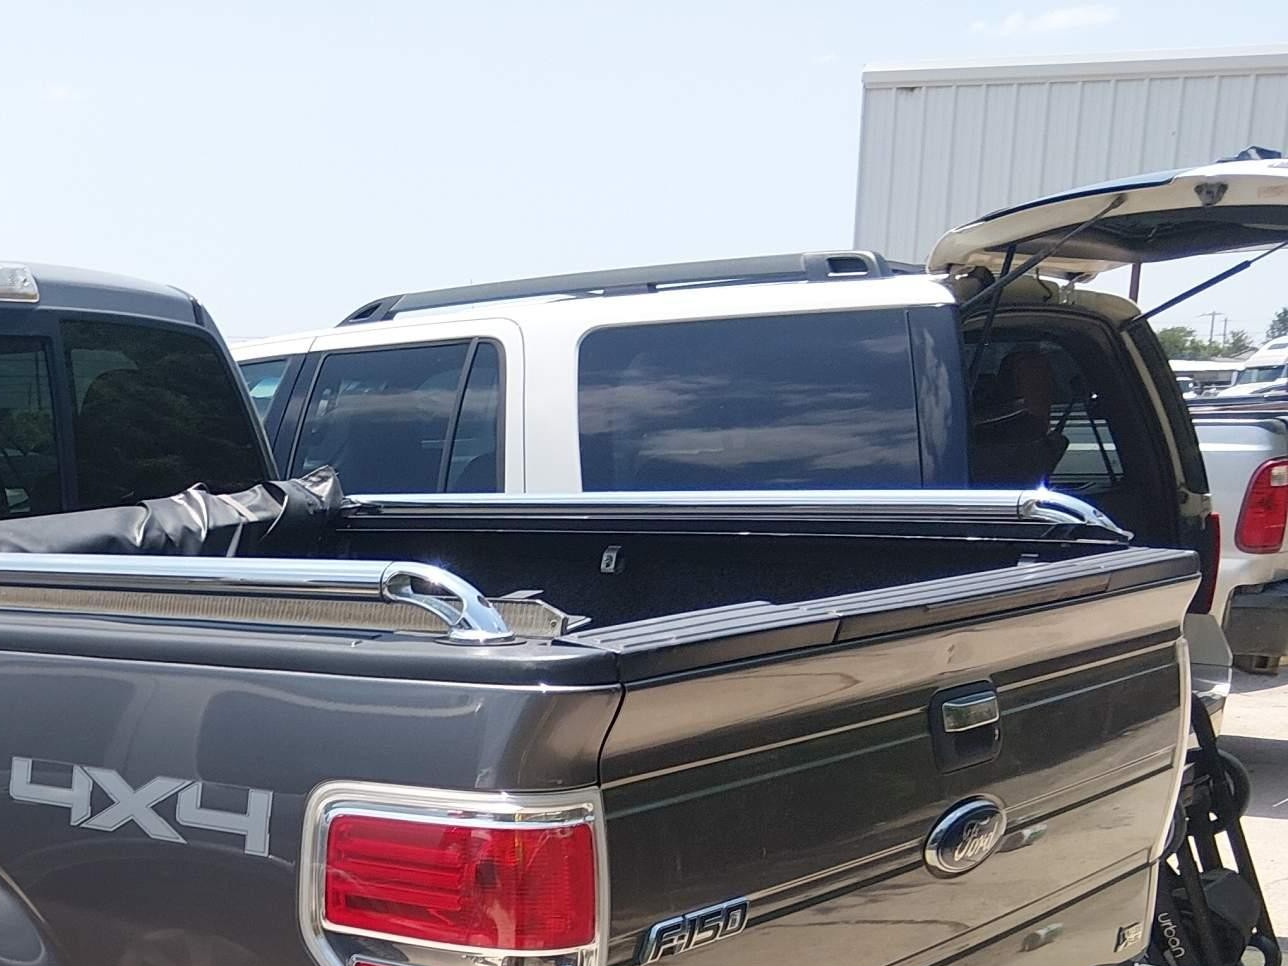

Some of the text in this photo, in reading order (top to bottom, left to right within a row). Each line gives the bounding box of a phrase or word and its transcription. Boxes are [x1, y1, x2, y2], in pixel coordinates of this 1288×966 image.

[954, 815, 1000, 861] Ford
[637, 897, 750, 966] F-150
[1157, 912, 1185, 958] urban
